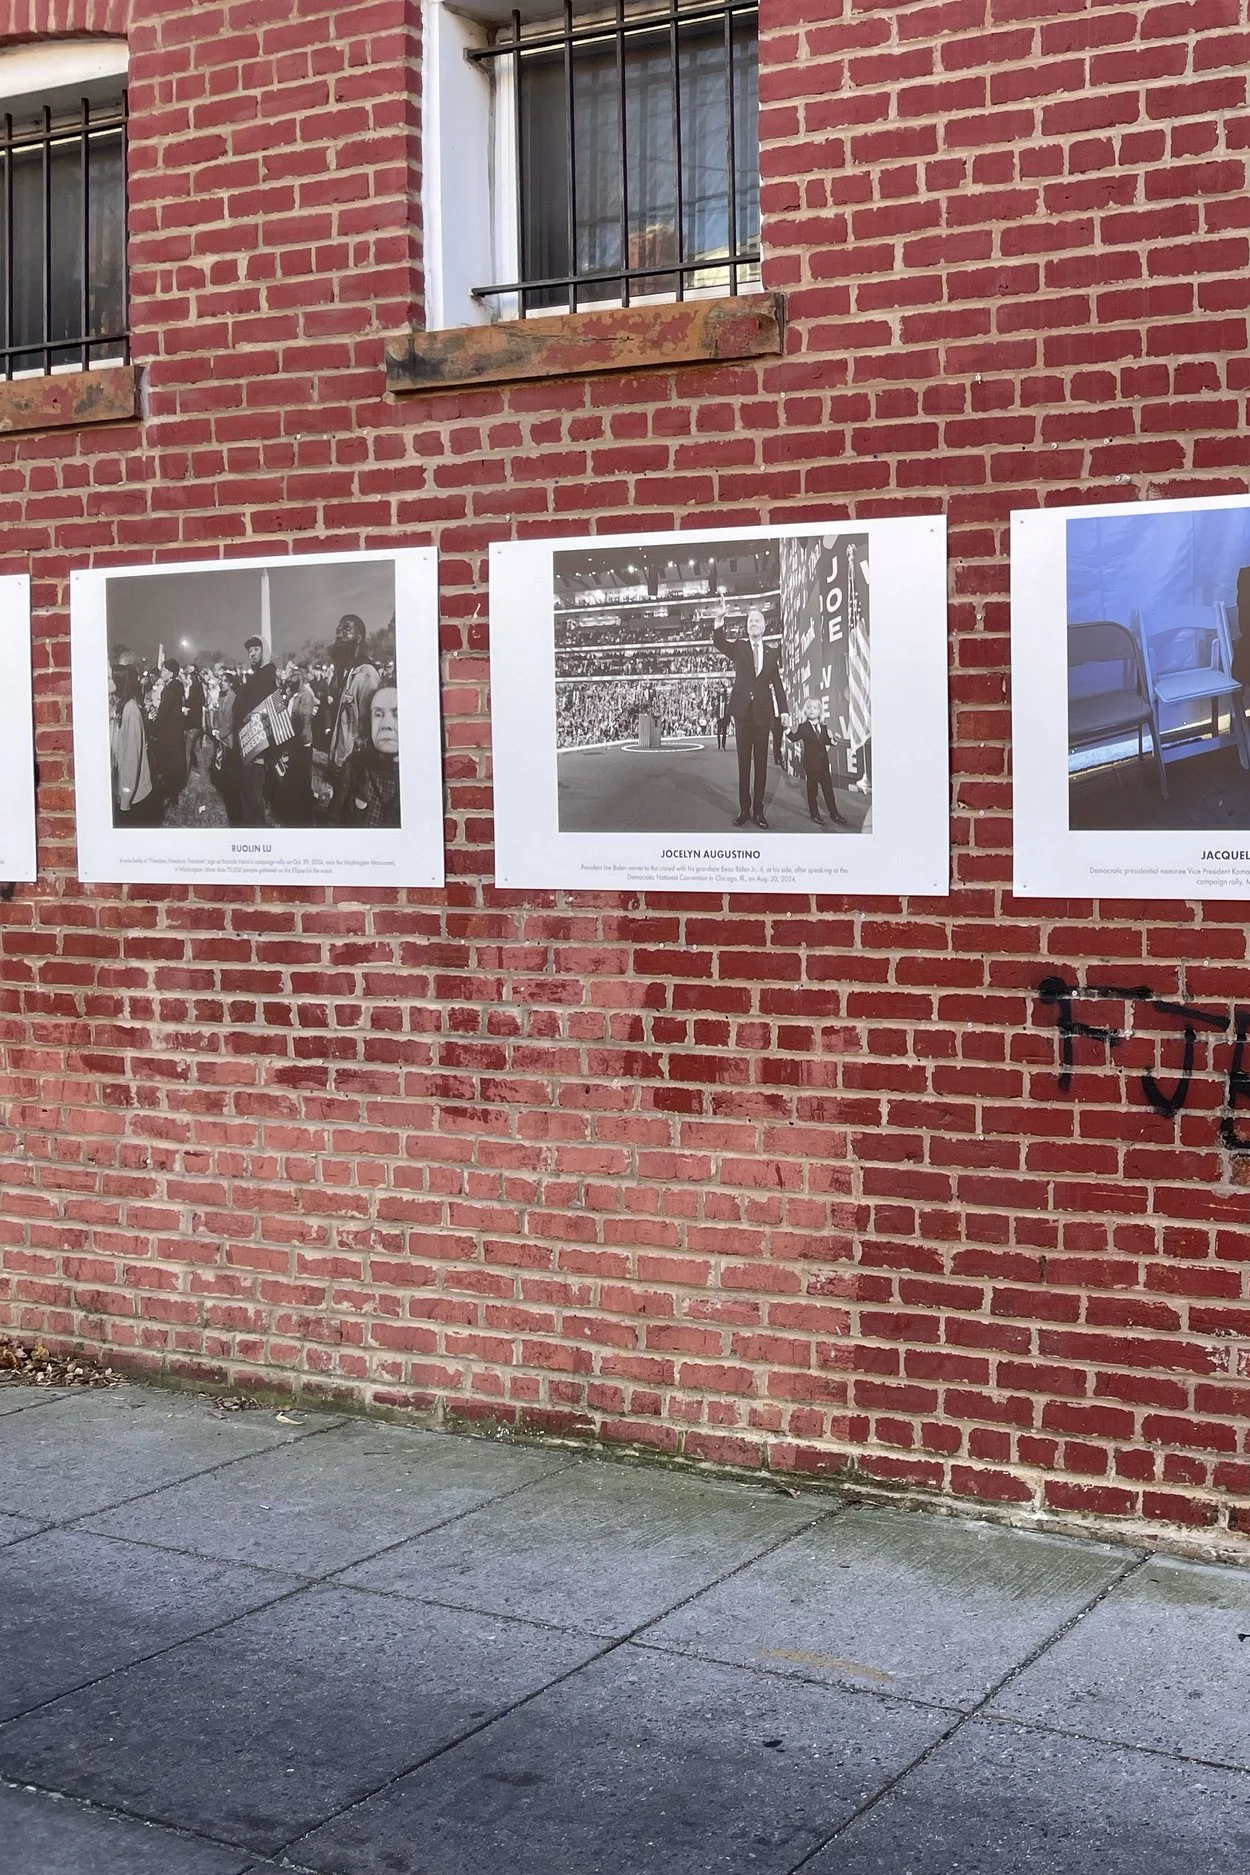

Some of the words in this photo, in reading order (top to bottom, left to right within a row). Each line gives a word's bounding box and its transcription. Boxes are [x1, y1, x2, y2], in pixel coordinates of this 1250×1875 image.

[826, 555, 843, 643] JOE
[660, 850, 700, 858] JOCELYN
[703, 850, 760, 859] AUGUSTINO
[1124, 867, 1159, 877] presidential
[1160, 867, 1186, 875] nominee
[1188, 867, 1201, 875] Vice
[1202, 867, 1230, 875] President
[1196, 877, 1228, 887] campaign
[1228, 877, 1244, 887] rally,
